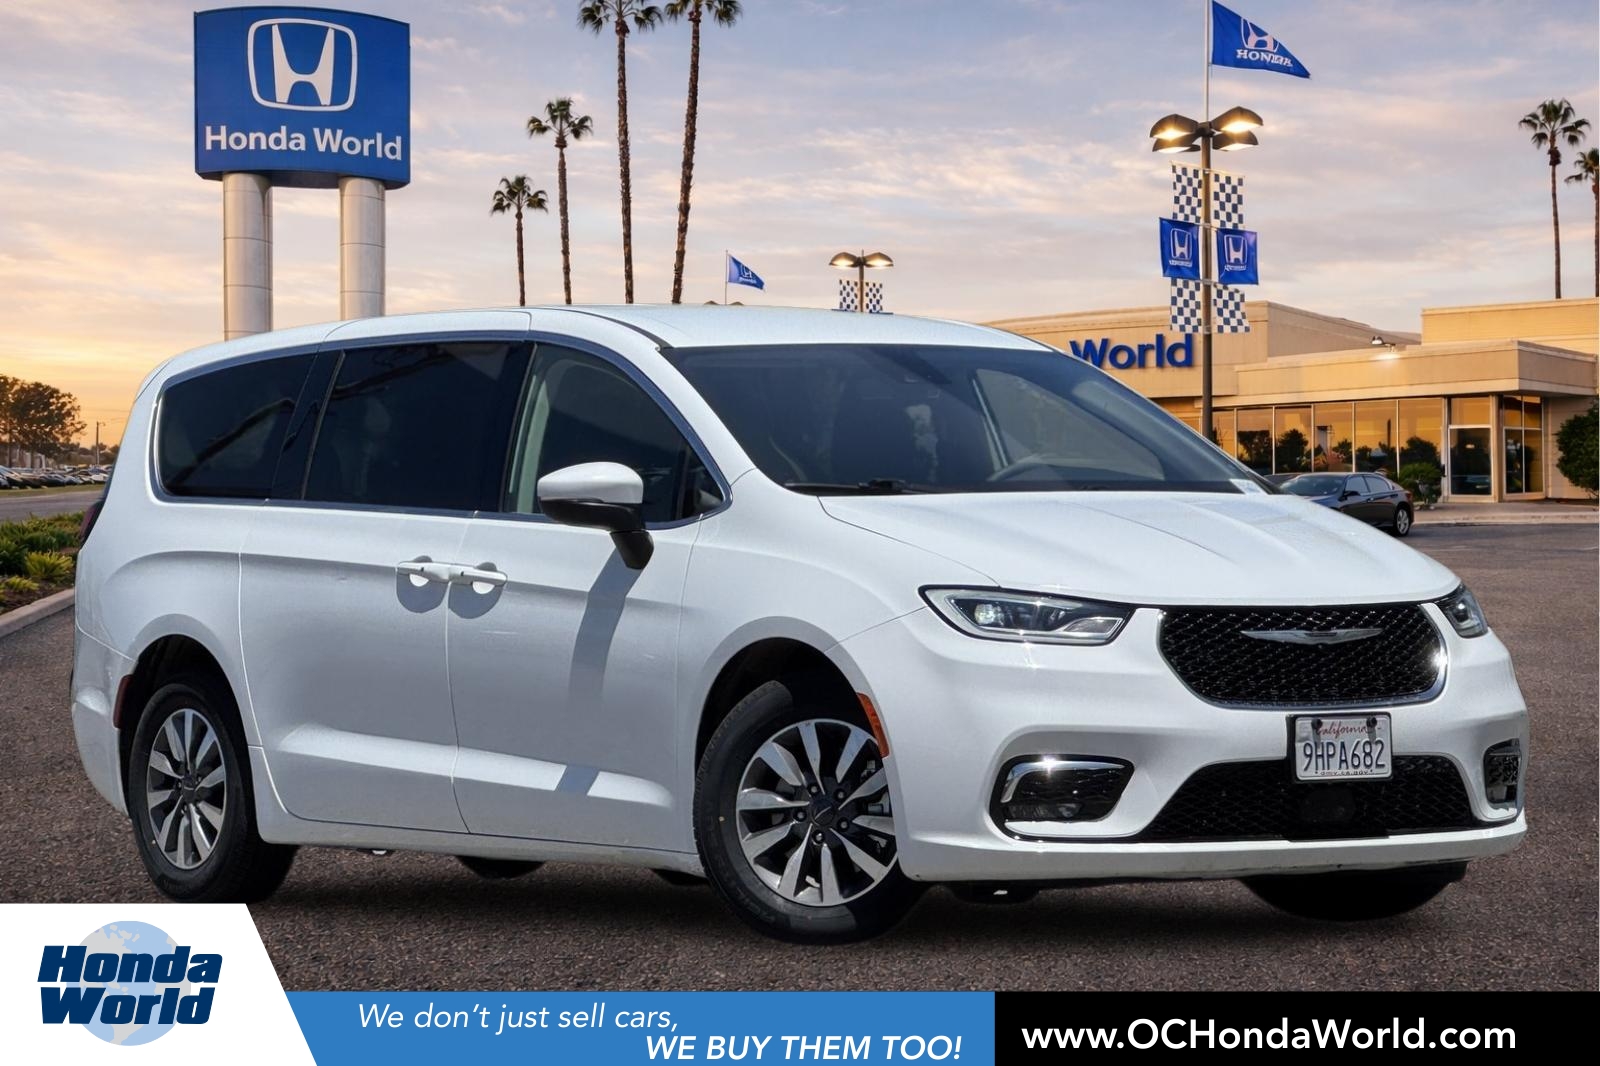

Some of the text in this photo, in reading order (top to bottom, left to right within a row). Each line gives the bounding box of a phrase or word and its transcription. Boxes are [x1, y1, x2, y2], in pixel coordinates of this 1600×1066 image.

[205, 125, 402, 160] Honda World
[1069, 333, 1194, 369] World
[1303, 739, 1386, 772] 9HPA682
